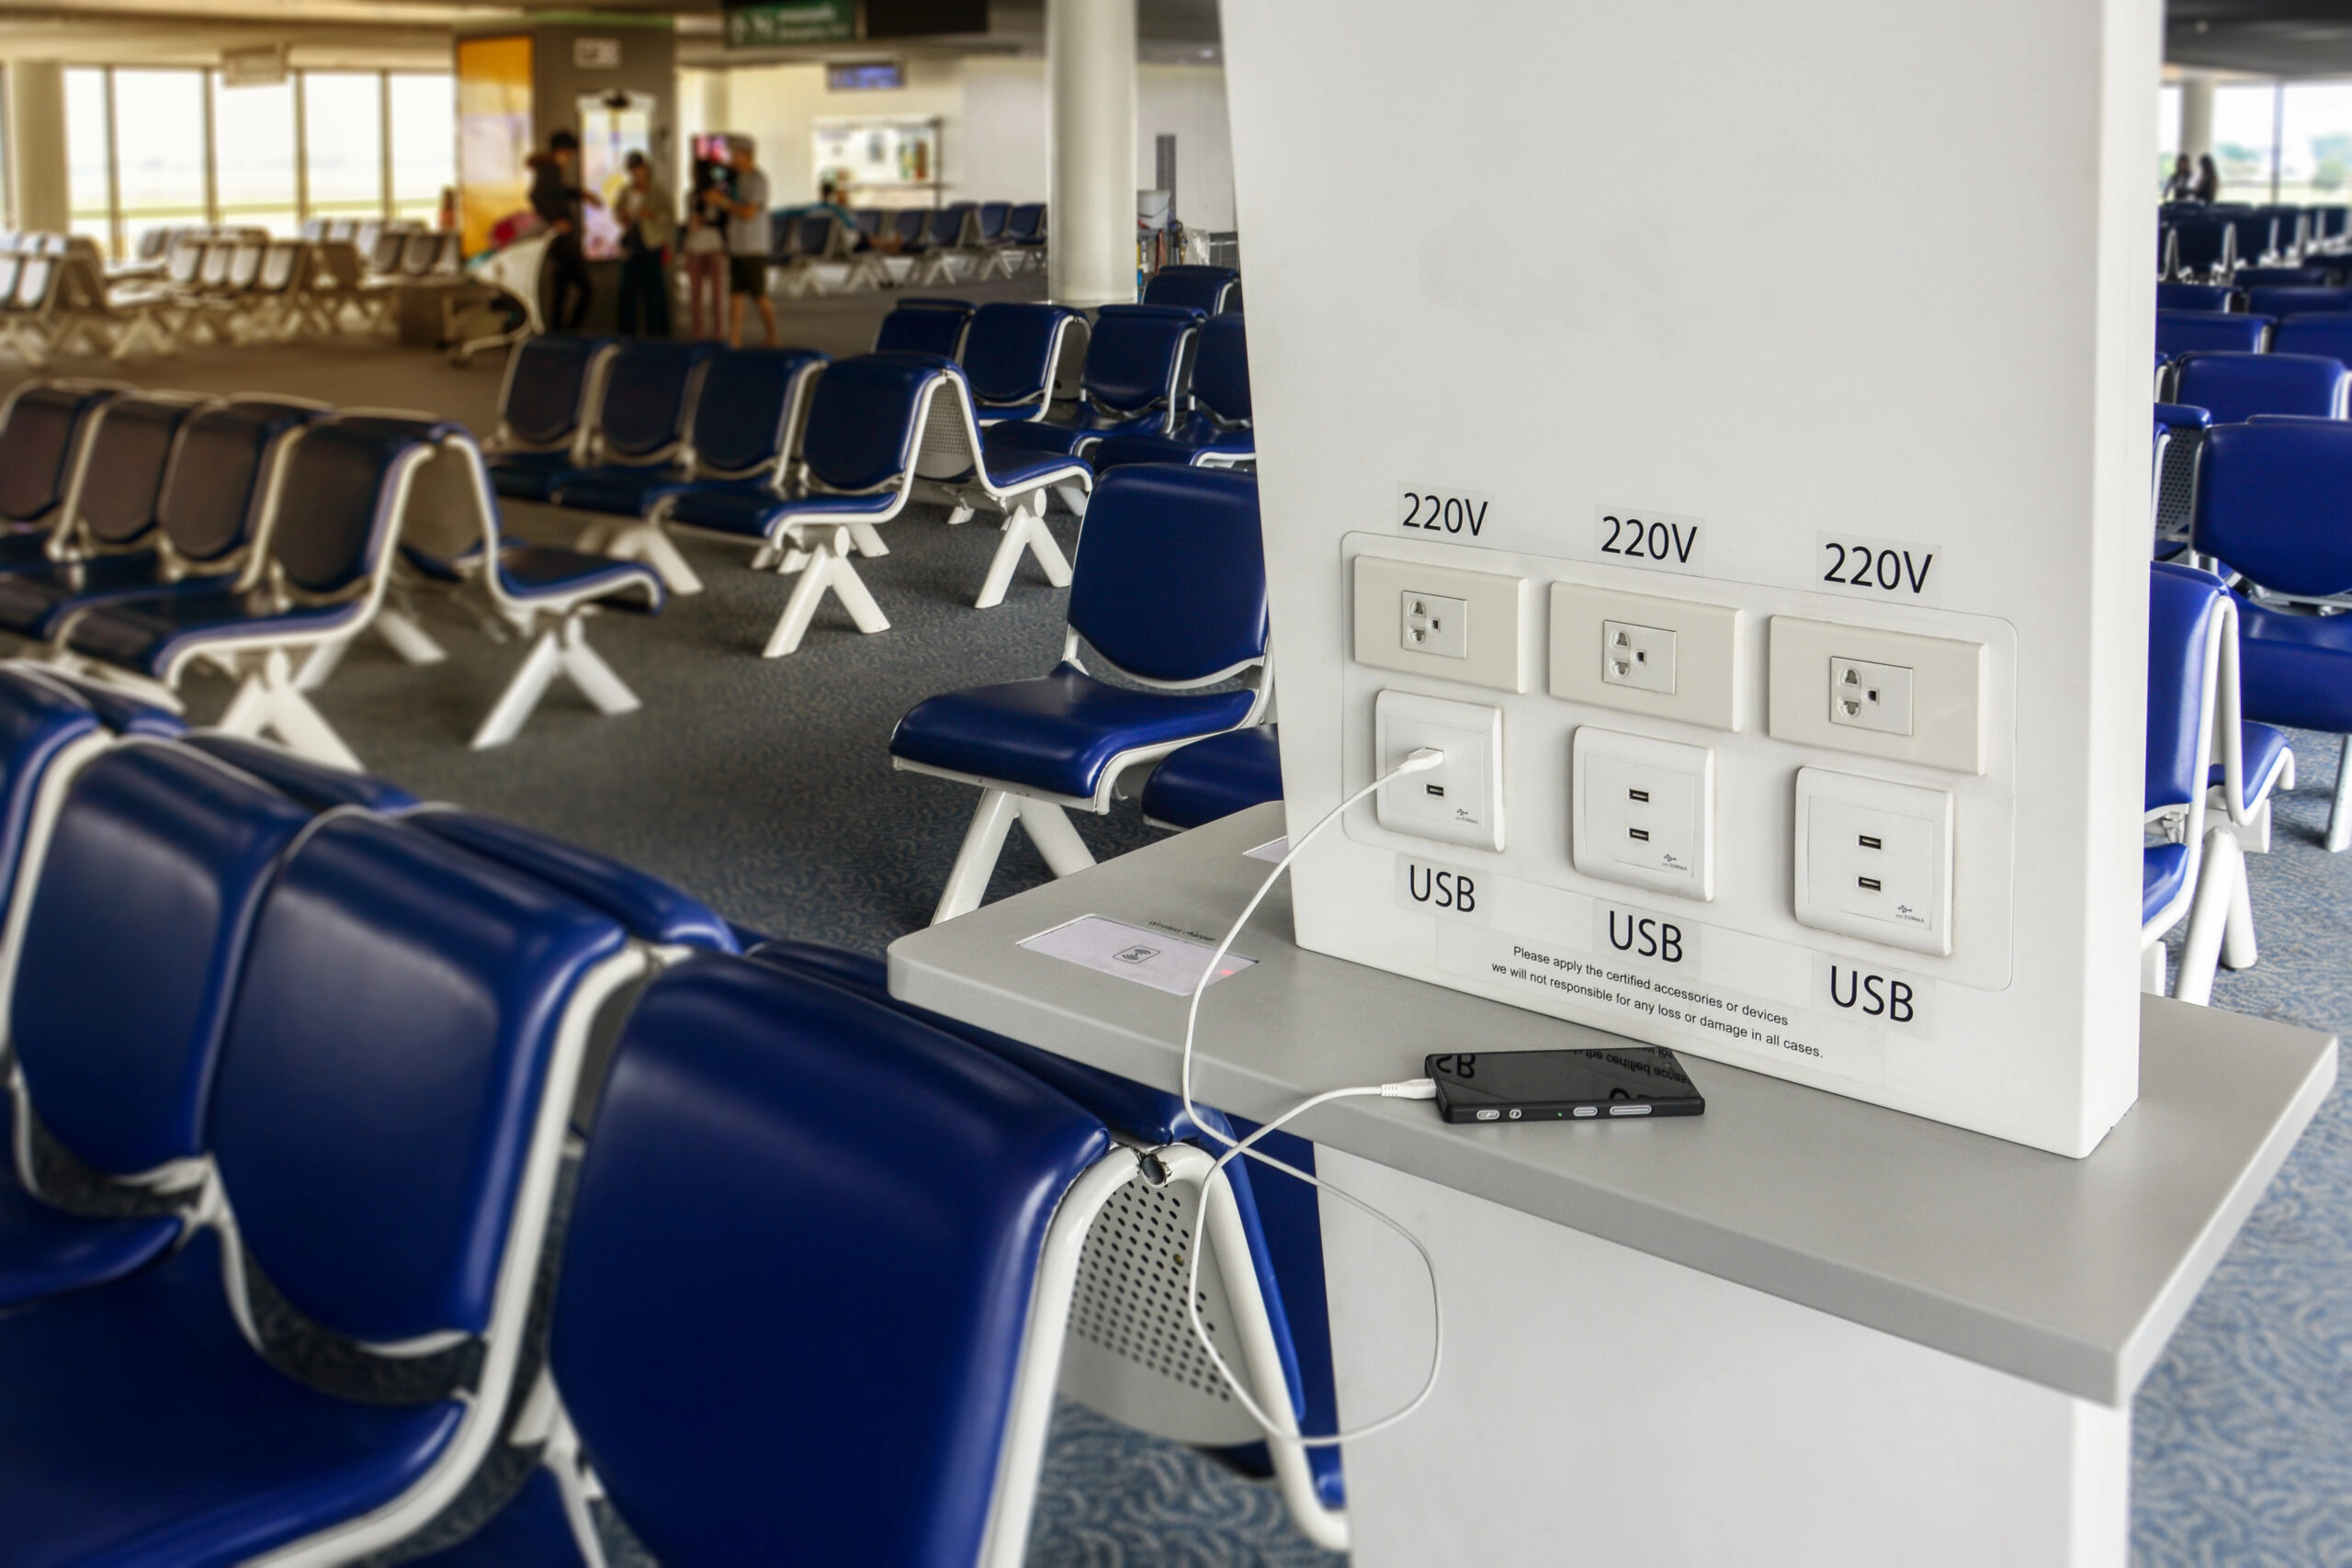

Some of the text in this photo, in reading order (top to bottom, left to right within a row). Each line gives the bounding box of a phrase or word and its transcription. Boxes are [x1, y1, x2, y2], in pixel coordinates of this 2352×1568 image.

[1402, 491, 1488, 536] 220V
[1600, 515, 1698, 564] 220V
[1824, 542, 1933, 594] 220V
[1409, 864, 1476, 913] USB
[1610, 910, 1683, 963] USB
[1491, 964, 1823, 1058] we will not responsible for any loss or damage in all cases.
[1513, 945, 1788, 1026] Please apply the certified accessories or devices
[1830, 964, 1914, 1022] USB
